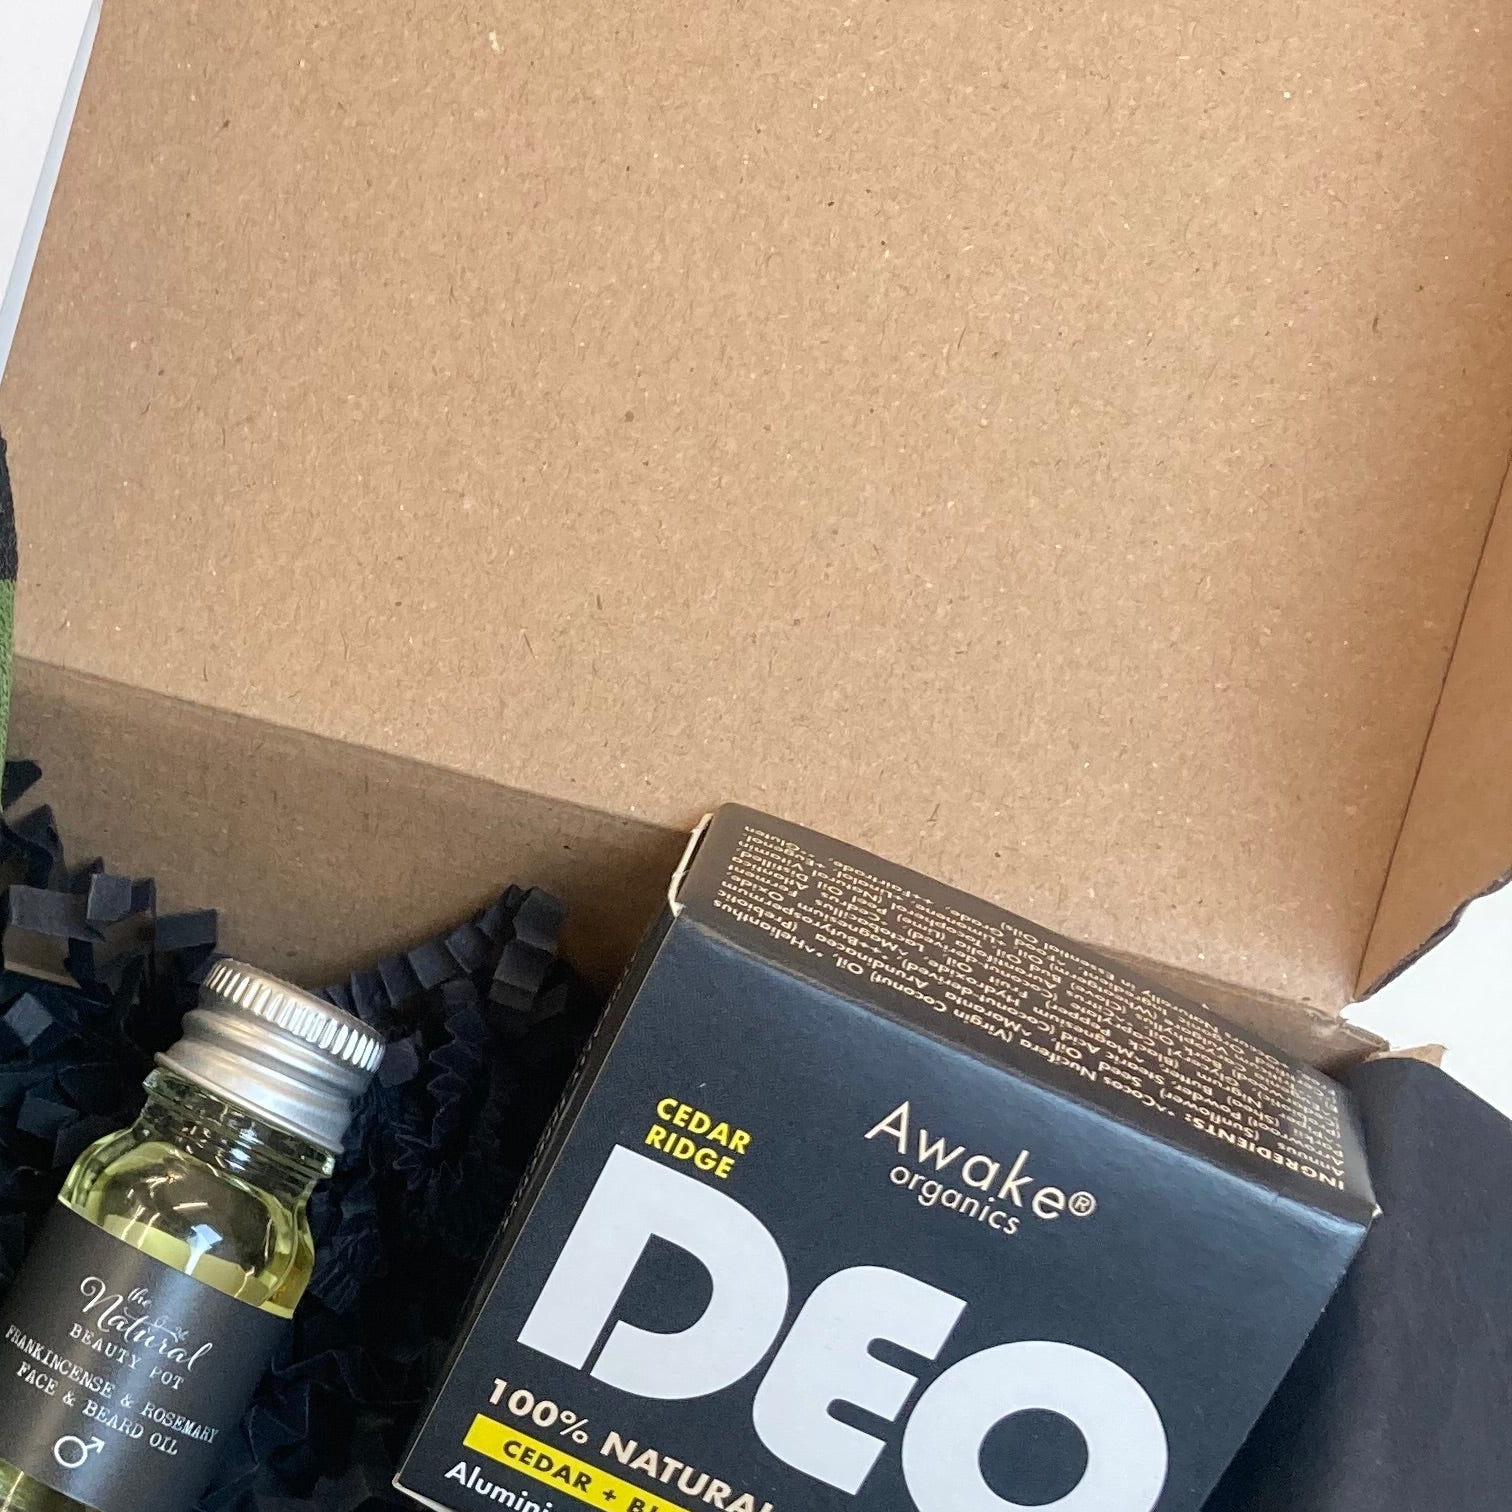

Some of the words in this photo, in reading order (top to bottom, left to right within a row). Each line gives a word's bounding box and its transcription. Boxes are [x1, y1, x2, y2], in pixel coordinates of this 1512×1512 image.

[716, 889, 798, 932] (Prebiotic
[796, 901, 908, 957] ^Magnesium
[813, 932, 928, 991] Arundinacea
[921, 954, 1019, 1007] Hydroxide,
[869, 969, 947, 1013] Coconut)
[894, 954, 1055, 1036] (Coconut-derived),
[943, 990, 1032, 1037] ^Maranta
[952, 1007, 1012, 1043] (Virgin
[1032, 1005, 1144, 1064] ^Magnesium
[1060, 1030, 1100, 1056] Acid
[1019, 1038, 1096, 1081] Nucifera
[1098, 1060, 1142, 1087] Seed
[1104, 1050, 1164, 1085] Stearic
[1158, 1062, 1212, 1096] Butter,
[656, 1097, 752, 1155] CEDAR
[1159, 1086, 1259, 1141] (Sunflower)
[1170, 1080, 1241, 1120] Powder,
[1226, 1094, 1278, 1127] (Shea)
[644, 1124, 736, 1179] RIDGE
[1184, 1112, 1343, 1191] INGREDIENTS:
[1247, 1115, 1344, 1167] Arrowroot)
[1276, 1140, 1344, 1178] Annuus
[1292, 1127, 1343, 1158] Parkii
[890, 1166, 1021, 1235] organics
[80, 1276, 213, 1371] Natural
[69, 1323, 141, 1370] BEAUTY
[149, 1366, 184, 1390] POT
[5, 1324, 116, 1398] FRANKINCENSE
[120, 1393, 132, 1409] &
[141, 1401, 219, 1444] ROSEMARY
[16, 1361, 58, 1396] FACE
[63, 1391, 76, 1407] &
[82, 1400, 144, 1439] BEARD
[149, 1432, 178, 1455] OIL
[489, 1377, 589, 1445] 100%
[503, 1440, 592, 1492] CEDAR
